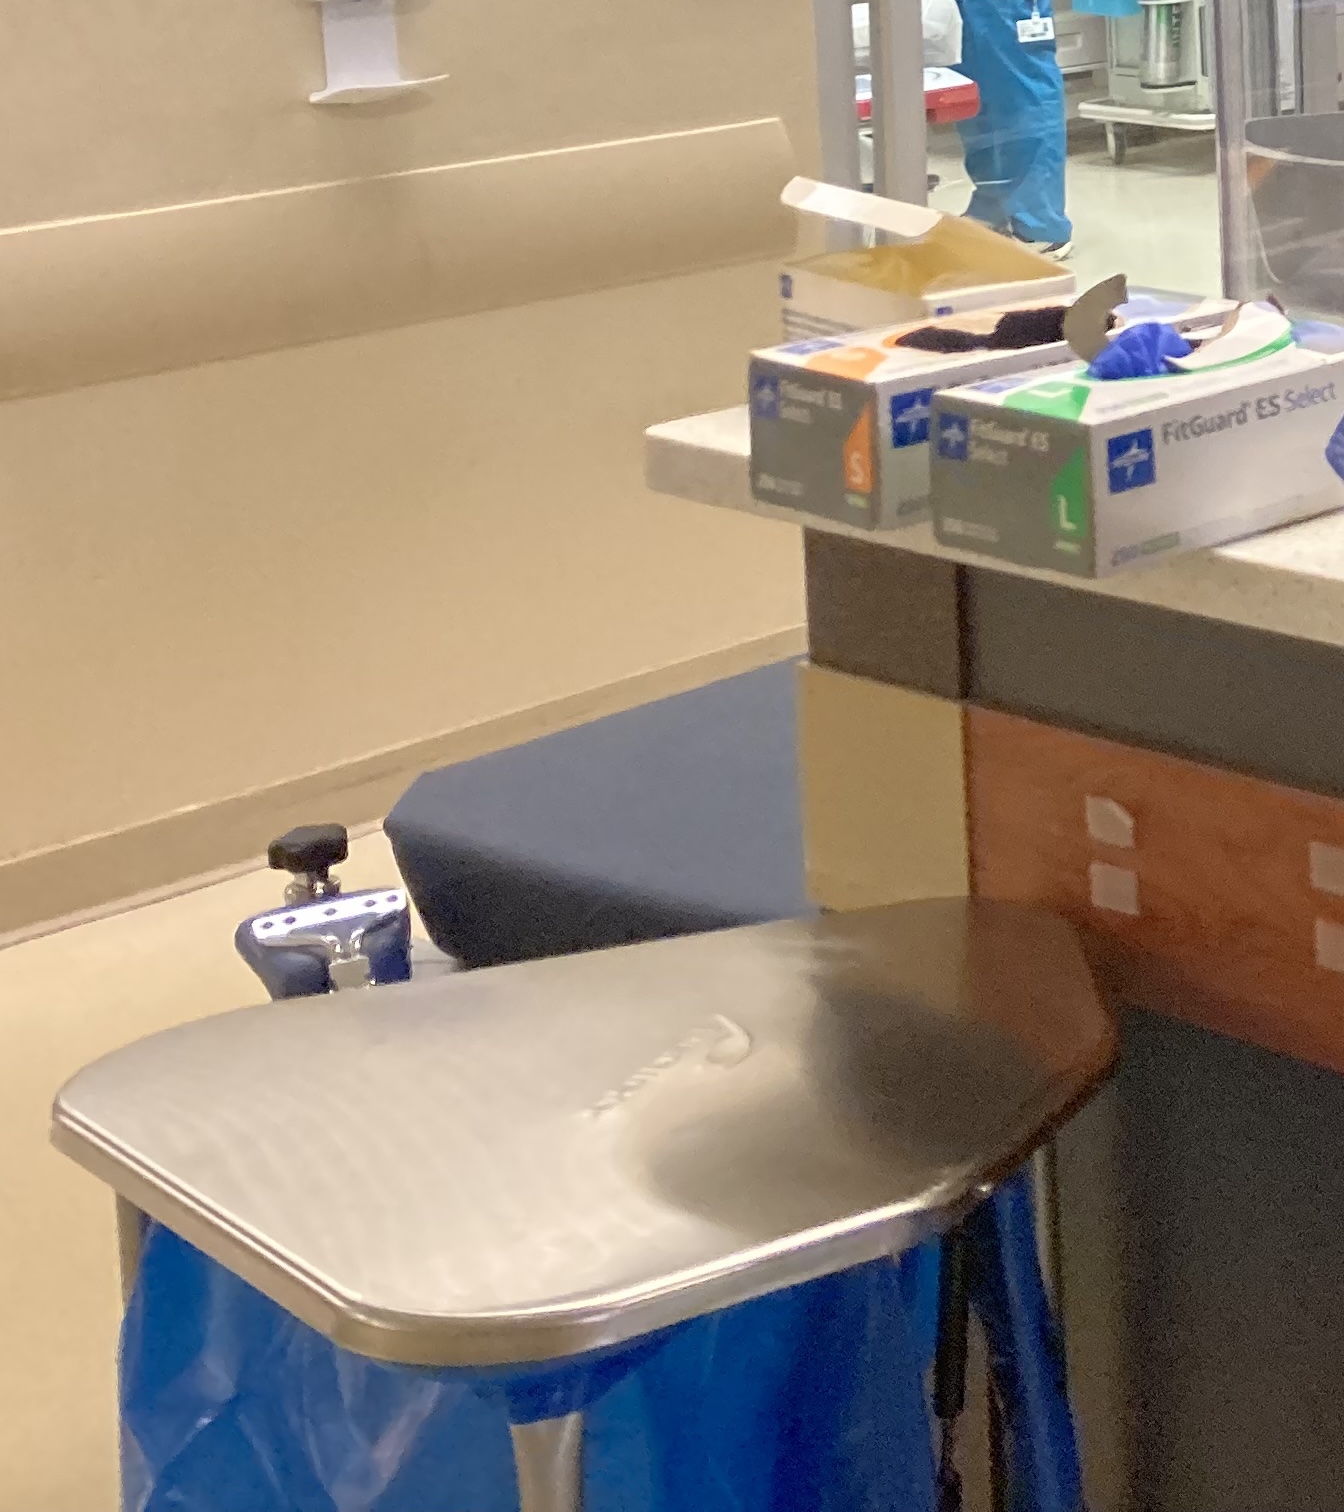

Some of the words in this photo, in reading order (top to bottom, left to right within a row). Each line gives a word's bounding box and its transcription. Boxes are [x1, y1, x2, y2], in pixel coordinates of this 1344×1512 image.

[1255, 395, 1281, 421] ES
[1283, 381, 1338, 413] Select
[849, 452, 864, 485] S
[1056, 494, 1078, 531] L
